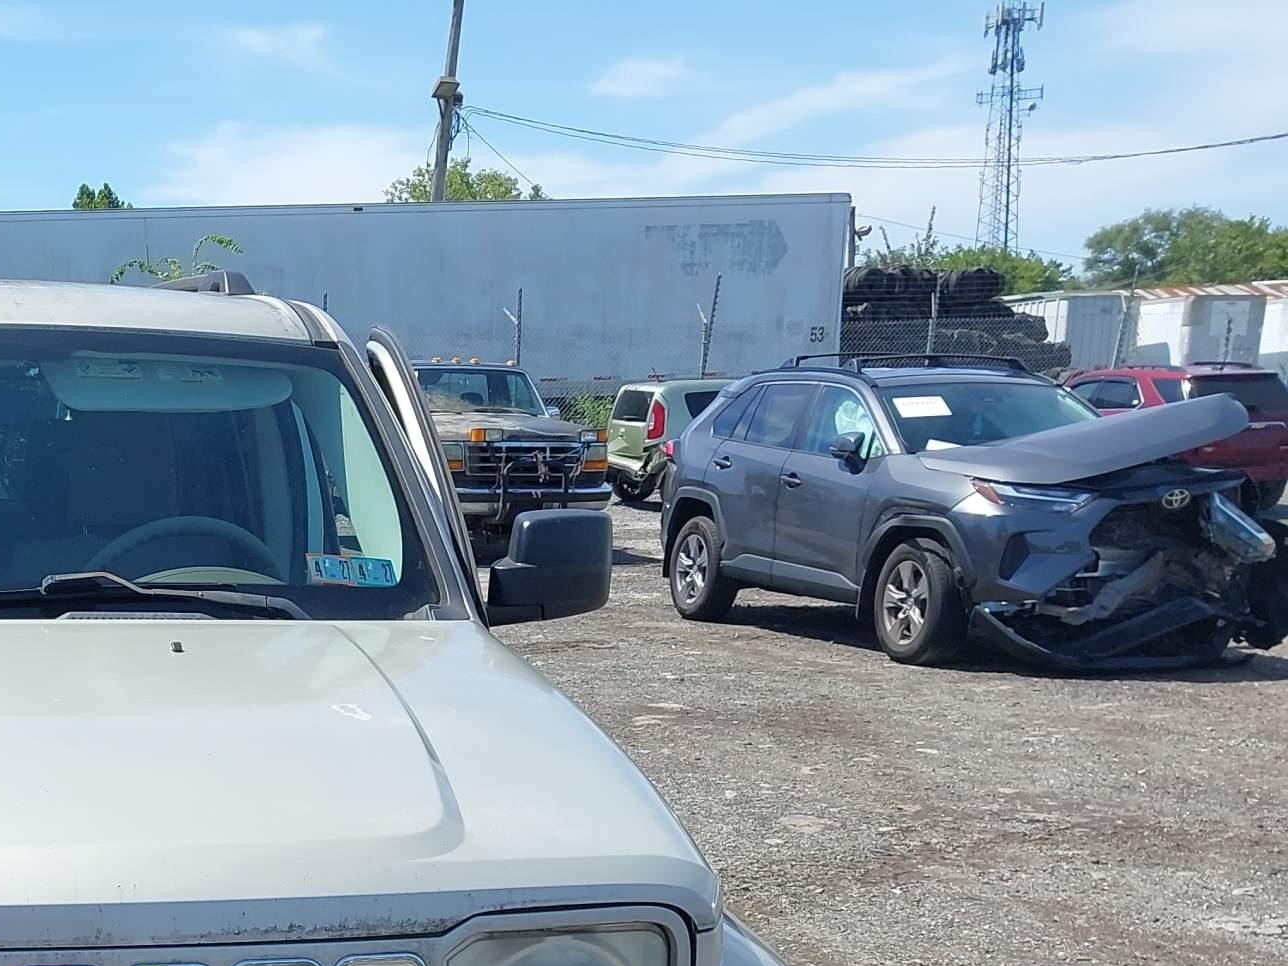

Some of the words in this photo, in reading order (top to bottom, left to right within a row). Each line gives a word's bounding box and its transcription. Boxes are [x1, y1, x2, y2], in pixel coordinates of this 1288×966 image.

[809, 326, 825, 343] 53
[314, 560, 324, 578] 4
[358, 564, 368, 582] 4
